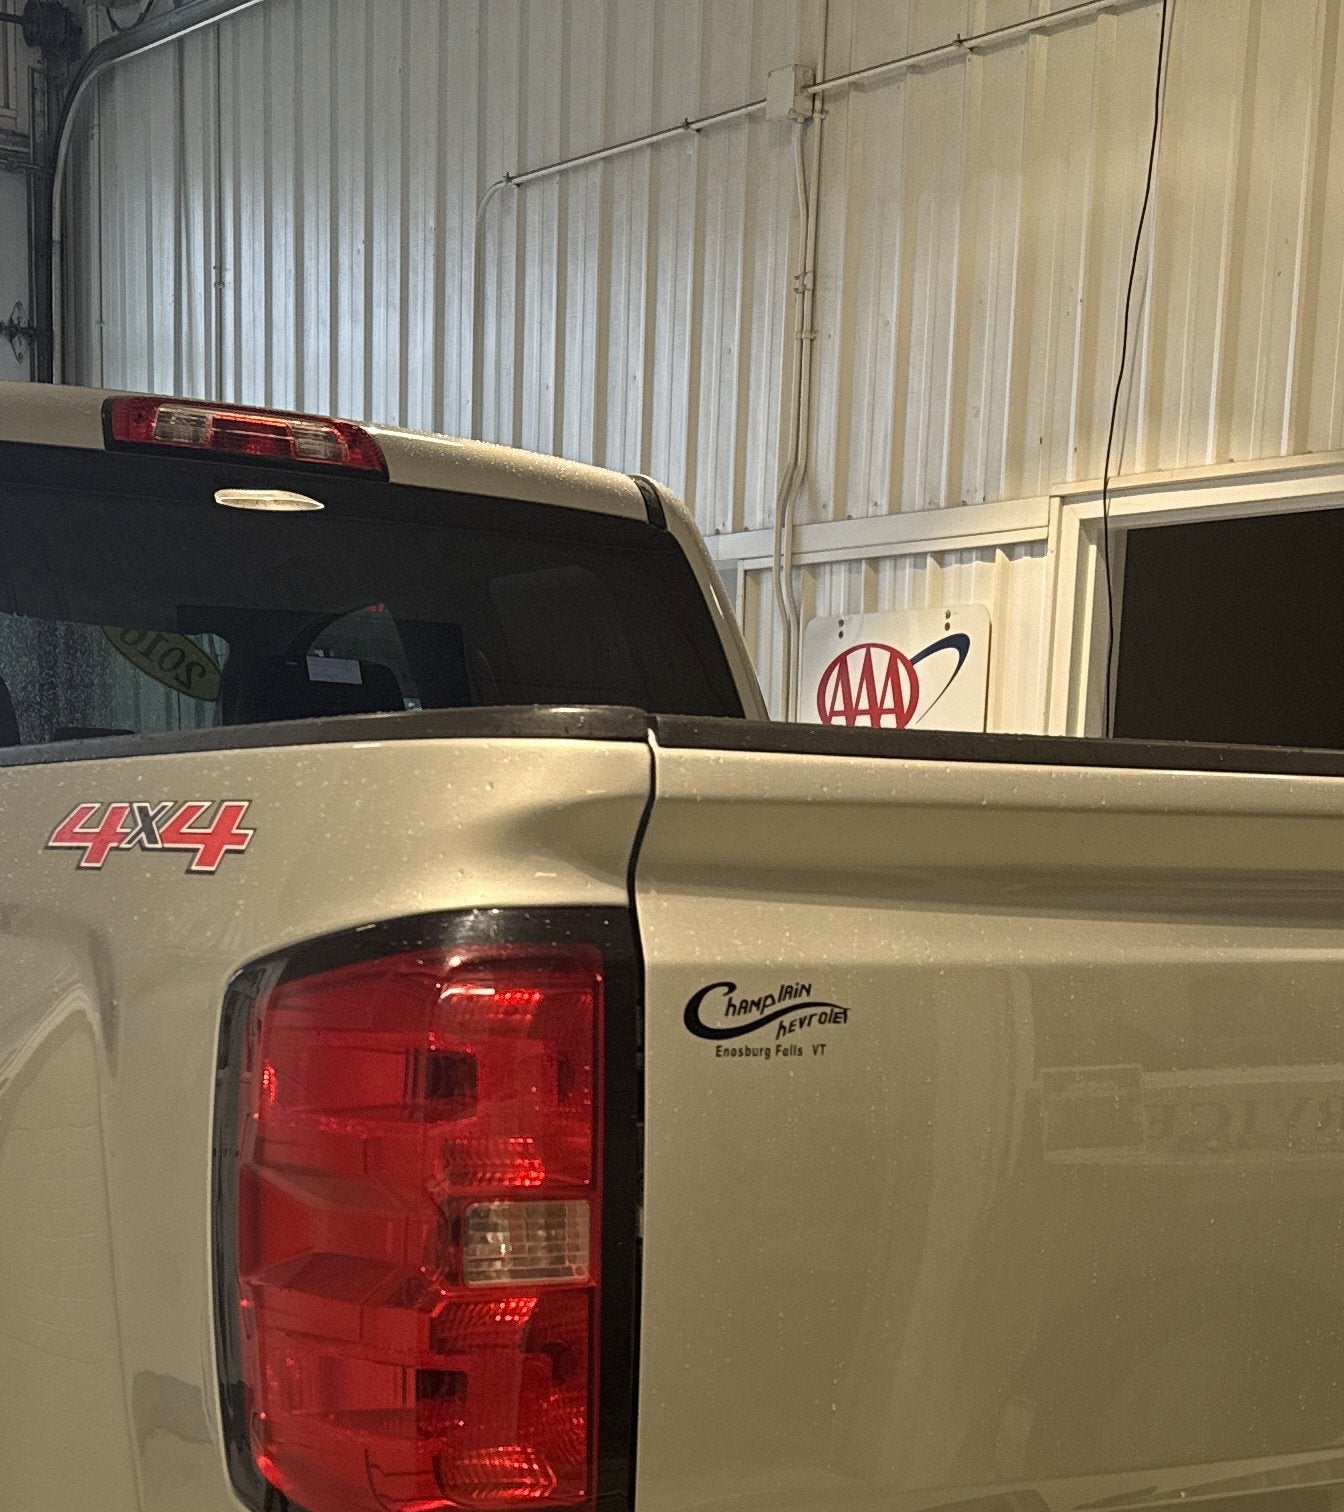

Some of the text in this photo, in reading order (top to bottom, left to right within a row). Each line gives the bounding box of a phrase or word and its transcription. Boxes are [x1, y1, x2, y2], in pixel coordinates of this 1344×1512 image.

[822, 643, 912, 729] AAA
[715, 1045, 771, 1060] Enosburg
[812, 1044, 826, 1056] VT
